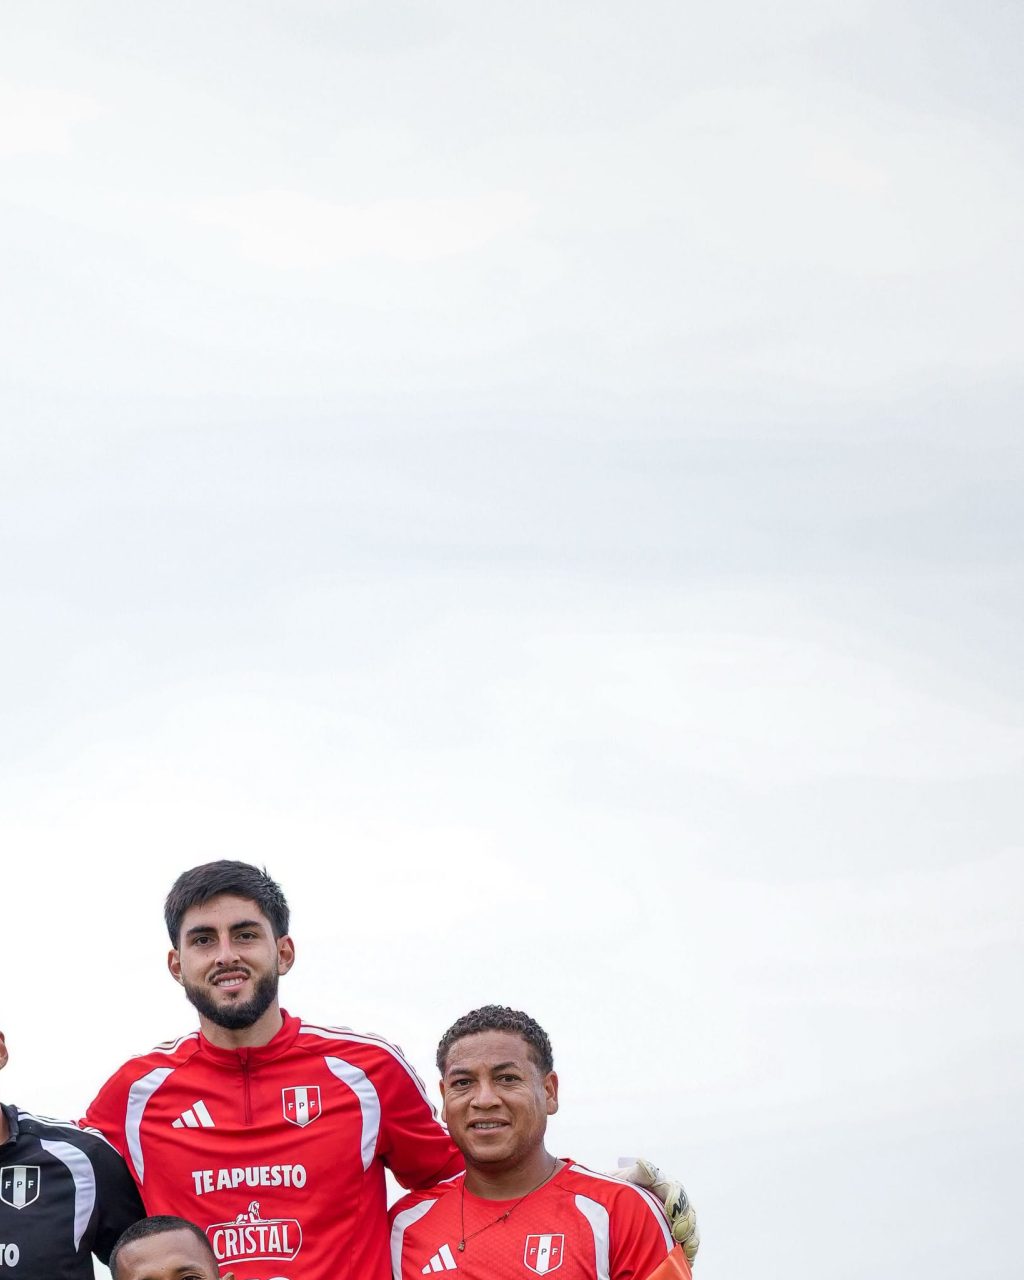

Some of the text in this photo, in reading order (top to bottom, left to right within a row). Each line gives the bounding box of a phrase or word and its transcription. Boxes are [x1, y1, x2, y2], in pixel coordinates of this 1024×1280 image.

[288, 1100, 315, 1111] FPF
[5, 1180, 34, 1190] FPF
[192, 1164, 307, 1195] TE APUESTO
[212, 1224, 294, 1260] CRISTAL
[529, 1247, 559, 1256] FPF
